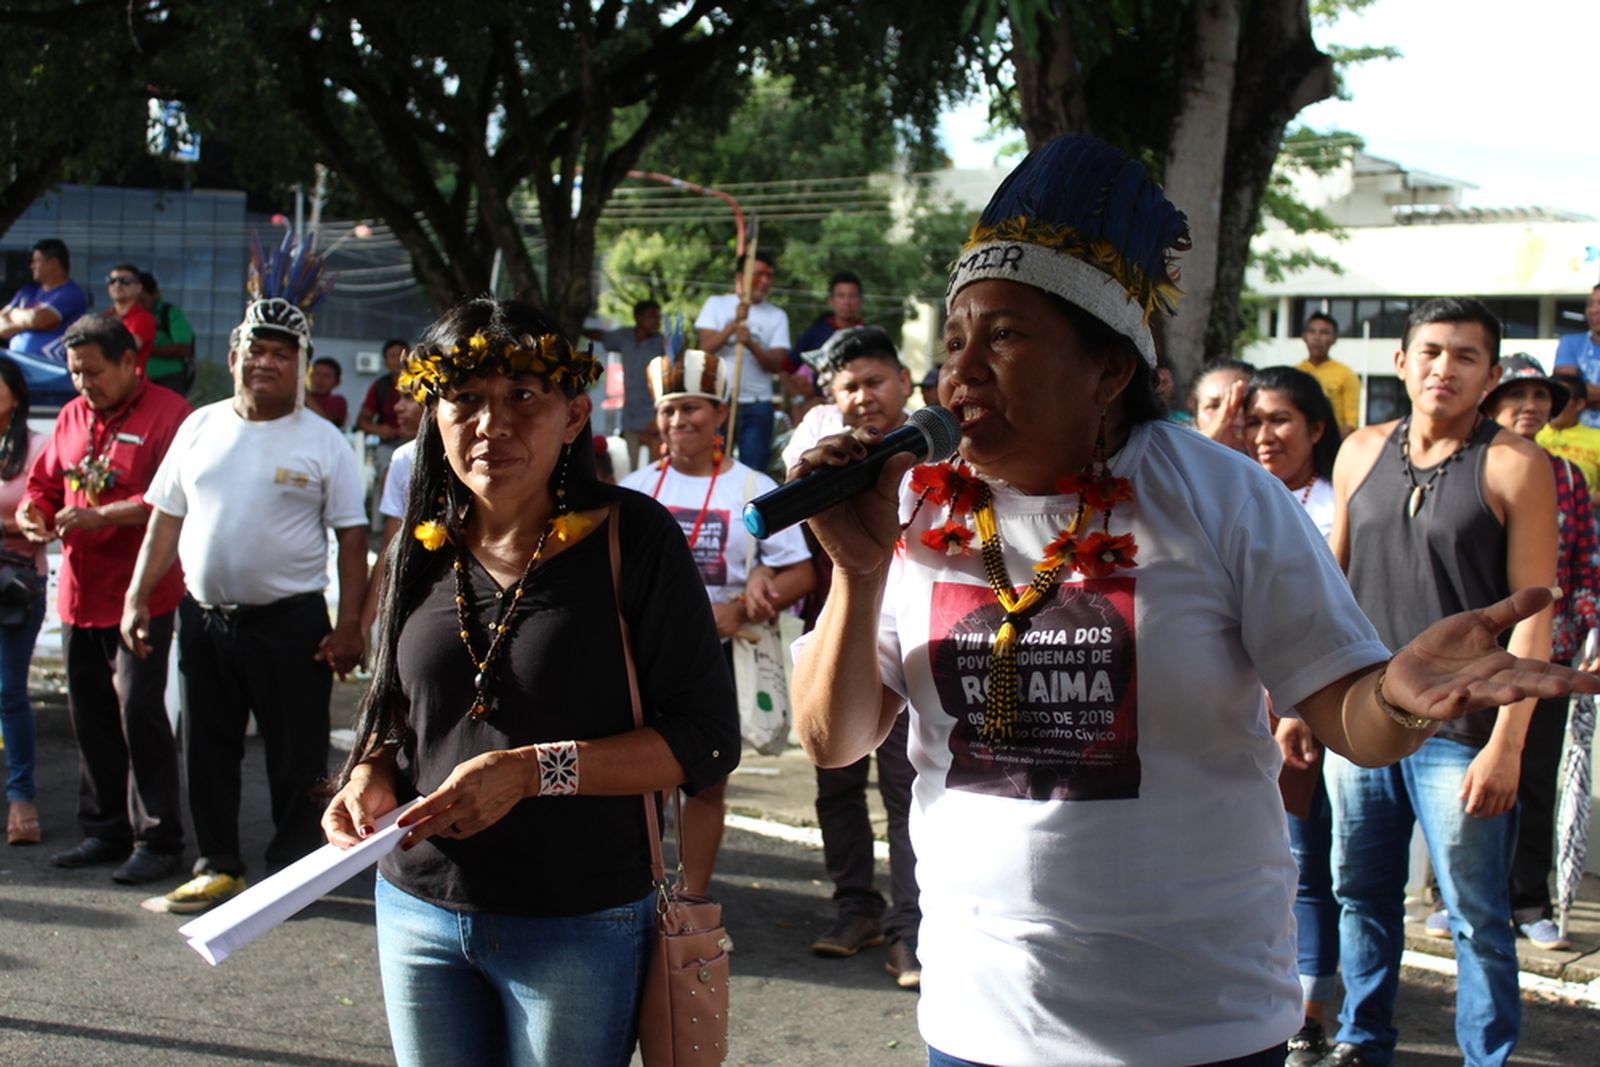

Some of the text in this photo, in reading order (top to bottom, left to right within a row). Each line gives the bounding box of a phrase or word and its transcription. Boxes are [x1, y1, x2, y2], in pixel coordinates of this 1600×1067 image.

[954, 626, 1113, 650] VIII MRCHA DOS
[956, 646, 1112, 670] POVO DÍGENAS DE
[960, 669, 1114, 705] RAIMA
[967, 711, 985, 726] 09
[1053, 711, 1074, 725] DE
[1079, 710, 1115, 725] 2019
[1031, 727, 1073, 740] Centro
